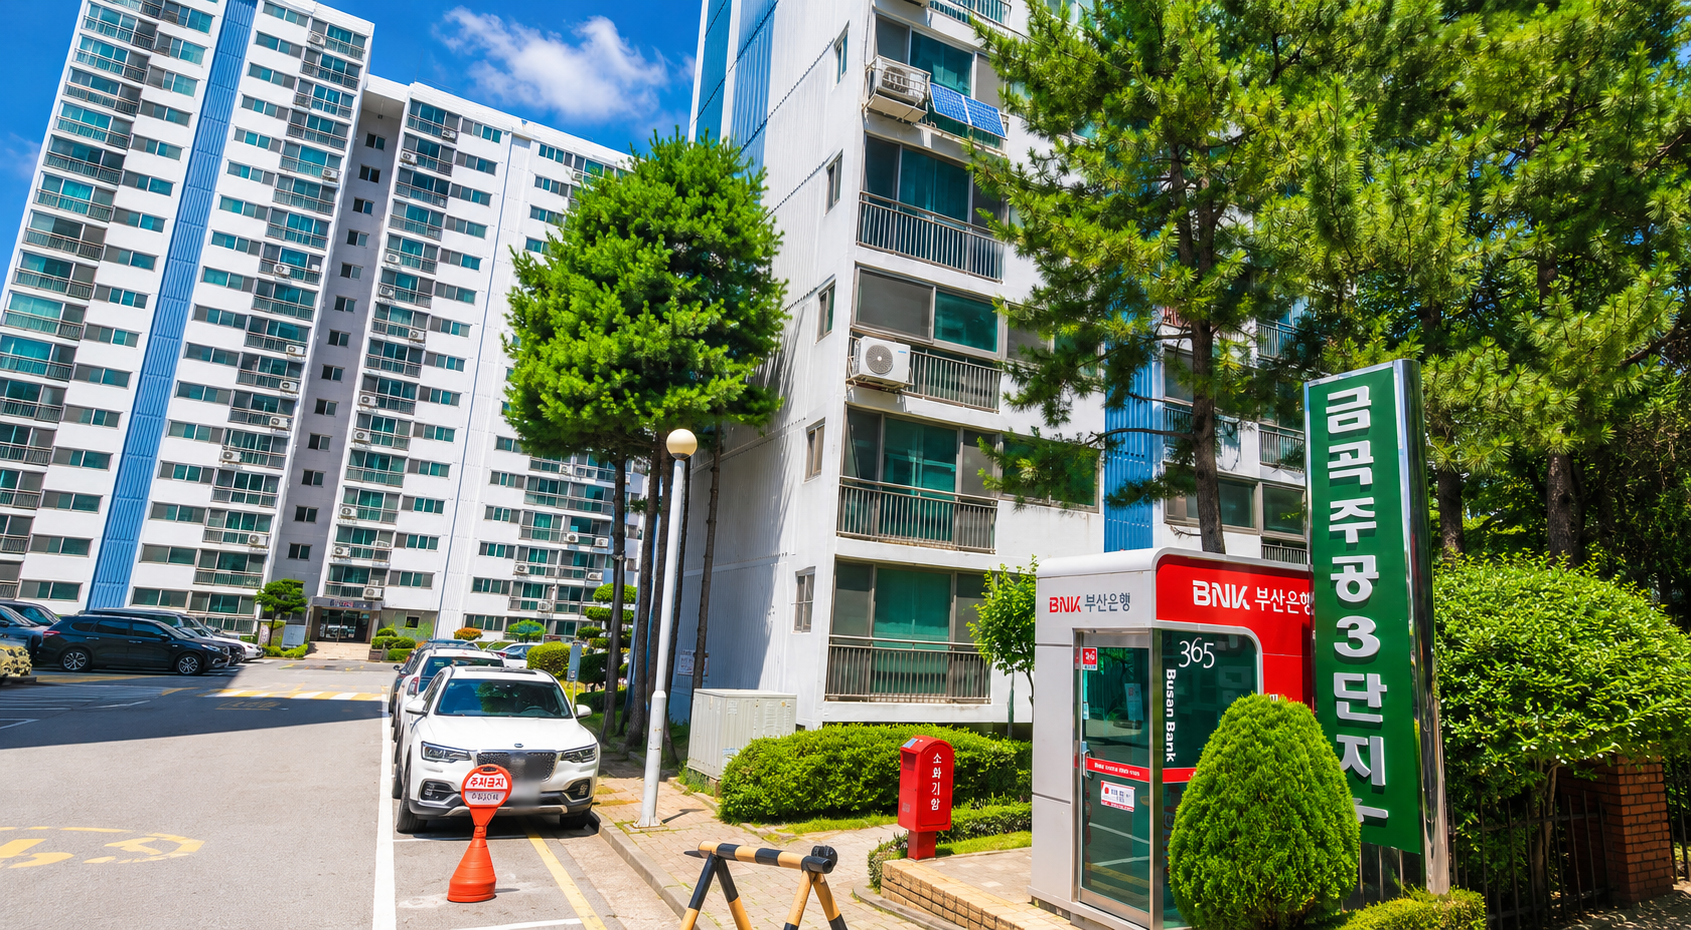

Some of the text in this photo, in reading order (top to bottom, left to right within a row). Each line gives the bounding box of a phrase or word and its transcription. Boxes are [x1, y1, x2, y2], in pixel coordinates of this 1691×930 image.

[1049, 592, 1131, 613] BNK 부산은행
[1193, 580, 1250, 610] BNK
[1179, 637, 1215, 669] 365
[1166, 669, 1177, 762] Busan Bank
